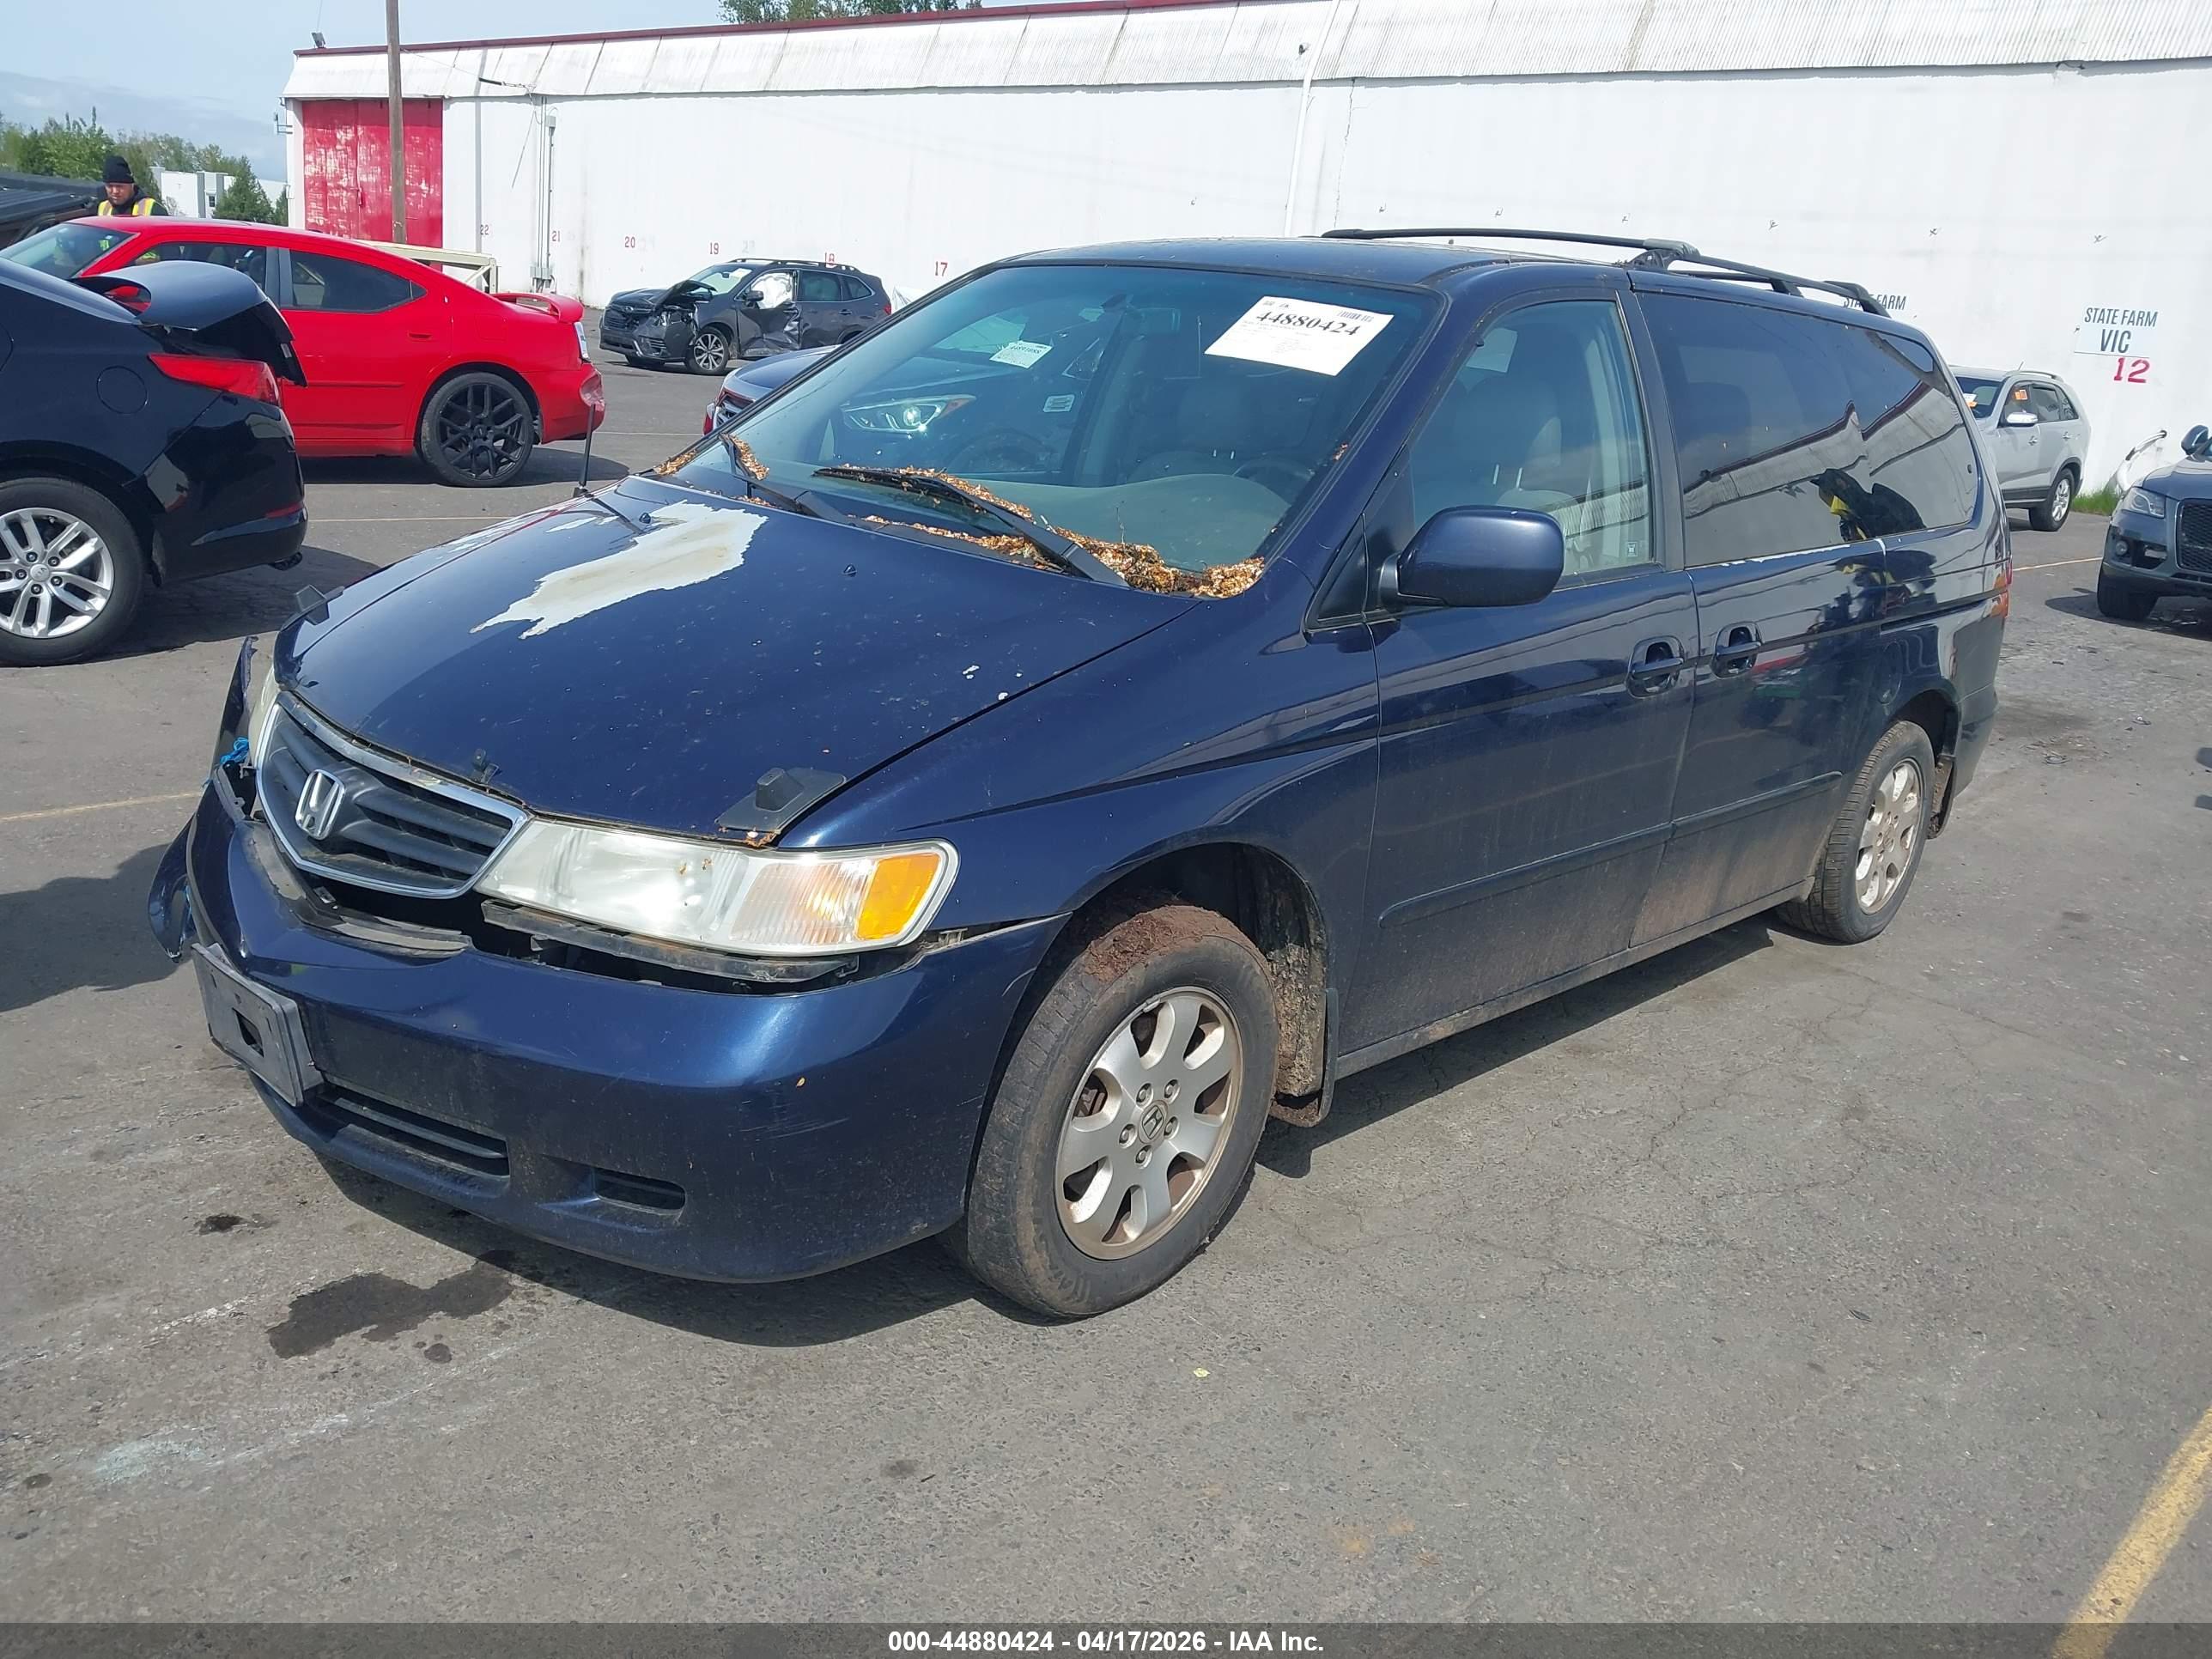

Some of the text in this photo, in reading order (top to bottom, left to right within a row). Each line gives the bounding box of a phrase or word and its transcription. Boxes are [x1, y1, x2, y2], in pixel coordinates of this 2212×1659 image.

[551, 230, 561, 242] 21
[624, 236, 636, 248] 20
[709, 242, 720, 255] 19
[935, 261, 949, 277] 17
[1256, 311, 1362, 336] 44880424
[2084, 307, 2159, 327] STATE FARM
[2100, 328, 2131, 354] VIC
[2113, 357, 2150, 383] 12
